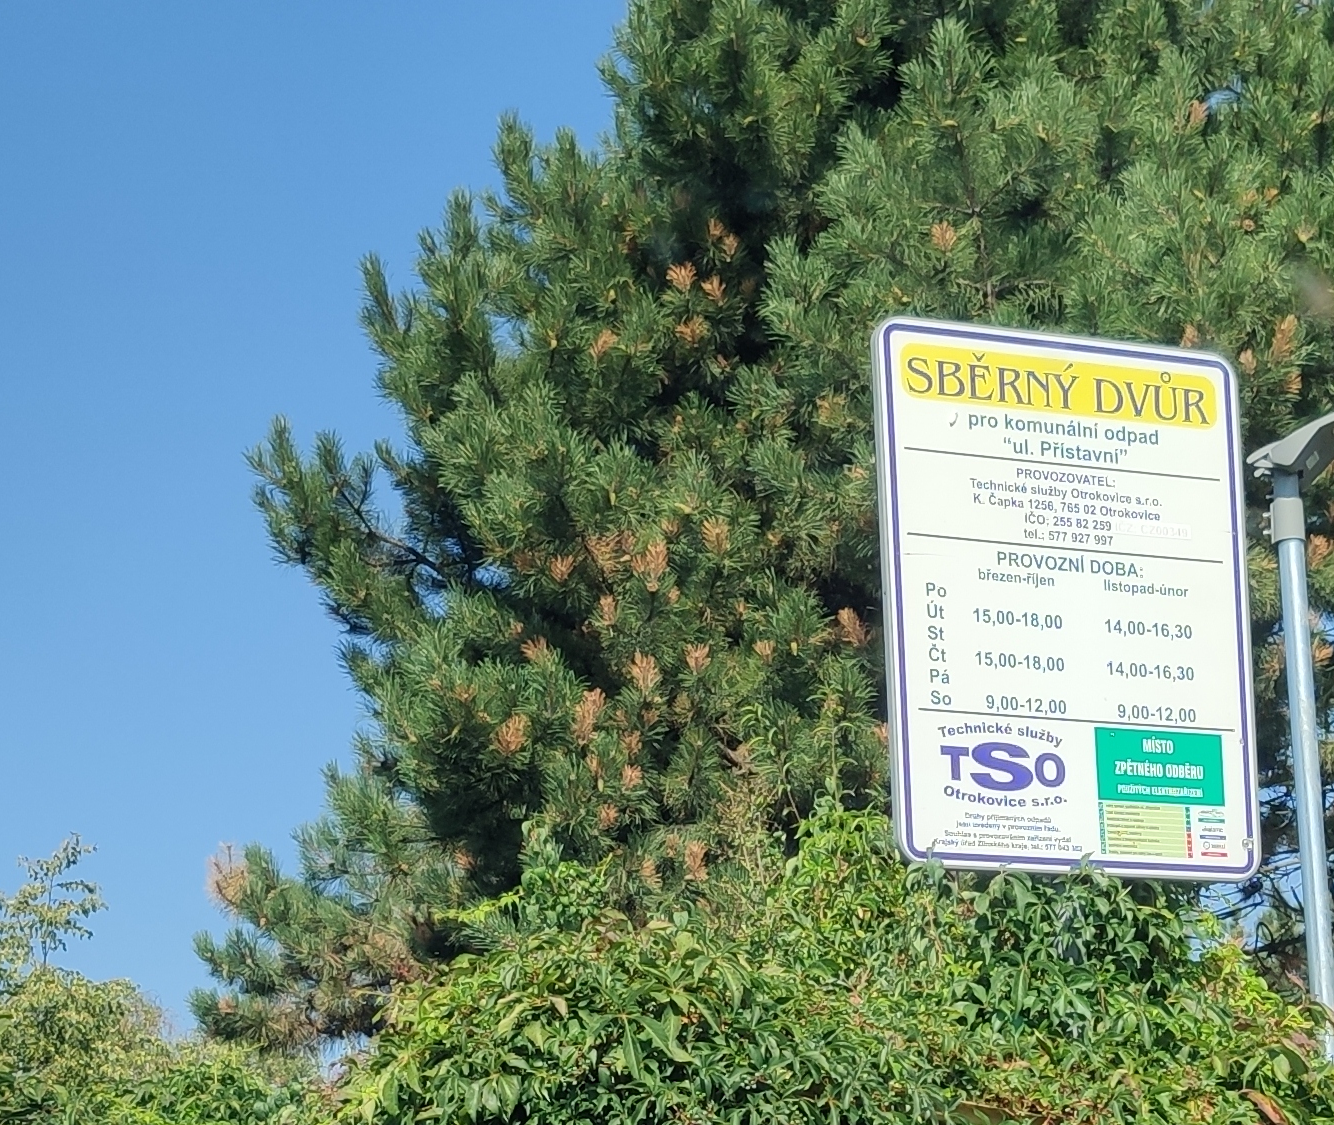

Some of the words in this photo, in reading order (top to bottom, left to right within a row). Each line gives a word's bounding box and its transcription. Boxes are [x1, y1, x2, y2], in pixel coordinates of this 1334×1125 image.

[906, 352, 1077, 411] SBĚRNÝ
[1093, 371, 1211, 426] DVŮR
[968, 414, 998, 431] pro
[1004, 415, 1098, 440] komunální
[1104, 422, 1159, 446] odpad
[1016, 468, 1116, 488] PROVOZOVATEL:
[970, 478, 1027, 494] Technické
[1031, 485, 1067, 500] služby
[1071, 488, 1132, 504] Otrokovice
[1135, 496, 1163, 507] s.r.o.
[973, 493, 986, 504] K.
[988, 492, 1024, 509] Čapka
[1060, 502, 1080, 514] 765
[1083, 504, 1097, 515] 02
[1100, 506, 1161, 521] Otrokovice
[1052, 516, 1073, 528] 255
[1076, 518, 1089, 529] 82
[1092, 520, 1112, 531] 259
[1048, 530, 1068, 543] 577
[1071, 532, 1091, 544] 927
[1094, 534, 1114, 546] 997
[997, 551, 1086, 574] PROVOZNÍ
[1090, 560, 1145, 579] DOBA:
[978, 568, 1056, 589] březen-říjen
[1104, 579, 1189, 598] listopad-únor
[925, 582, 947, 598] Po
[926, 601, 945, 620] Út
[972, 608, 1063, 631] 15,00-18,00
[927, 626, 945, 641] St
[1104, 619, 1193, 640] 14,00-16,30
[928, 643, 947, 663] Čt
[975, 650, 1065, 673] 15,00-18,00
[929, 669, 950, 684] Pá
[1106, 661, 1195, 682] 14,00-16,30
[930, 691, 952, 706] So
[985, 695, 1067, 715] 9,00-12,00
[1117, 704, 1197, 725] 9,00-12,00
[938, 722, 1013, 738] Technické
[1017, 725, 1063, 748] služby
[1142, 736, 1174, 754] MÍSTO
[940, 741, 1066, 792] TSO
[1114, 758, 1163, 777] ZPĚTNÉHO
[1165, 763, 1204, 780] ODBĚRU
[943, 785, 1026, 808] Otrokovice
[1031, 796, 1068, 808] s.r.o.
